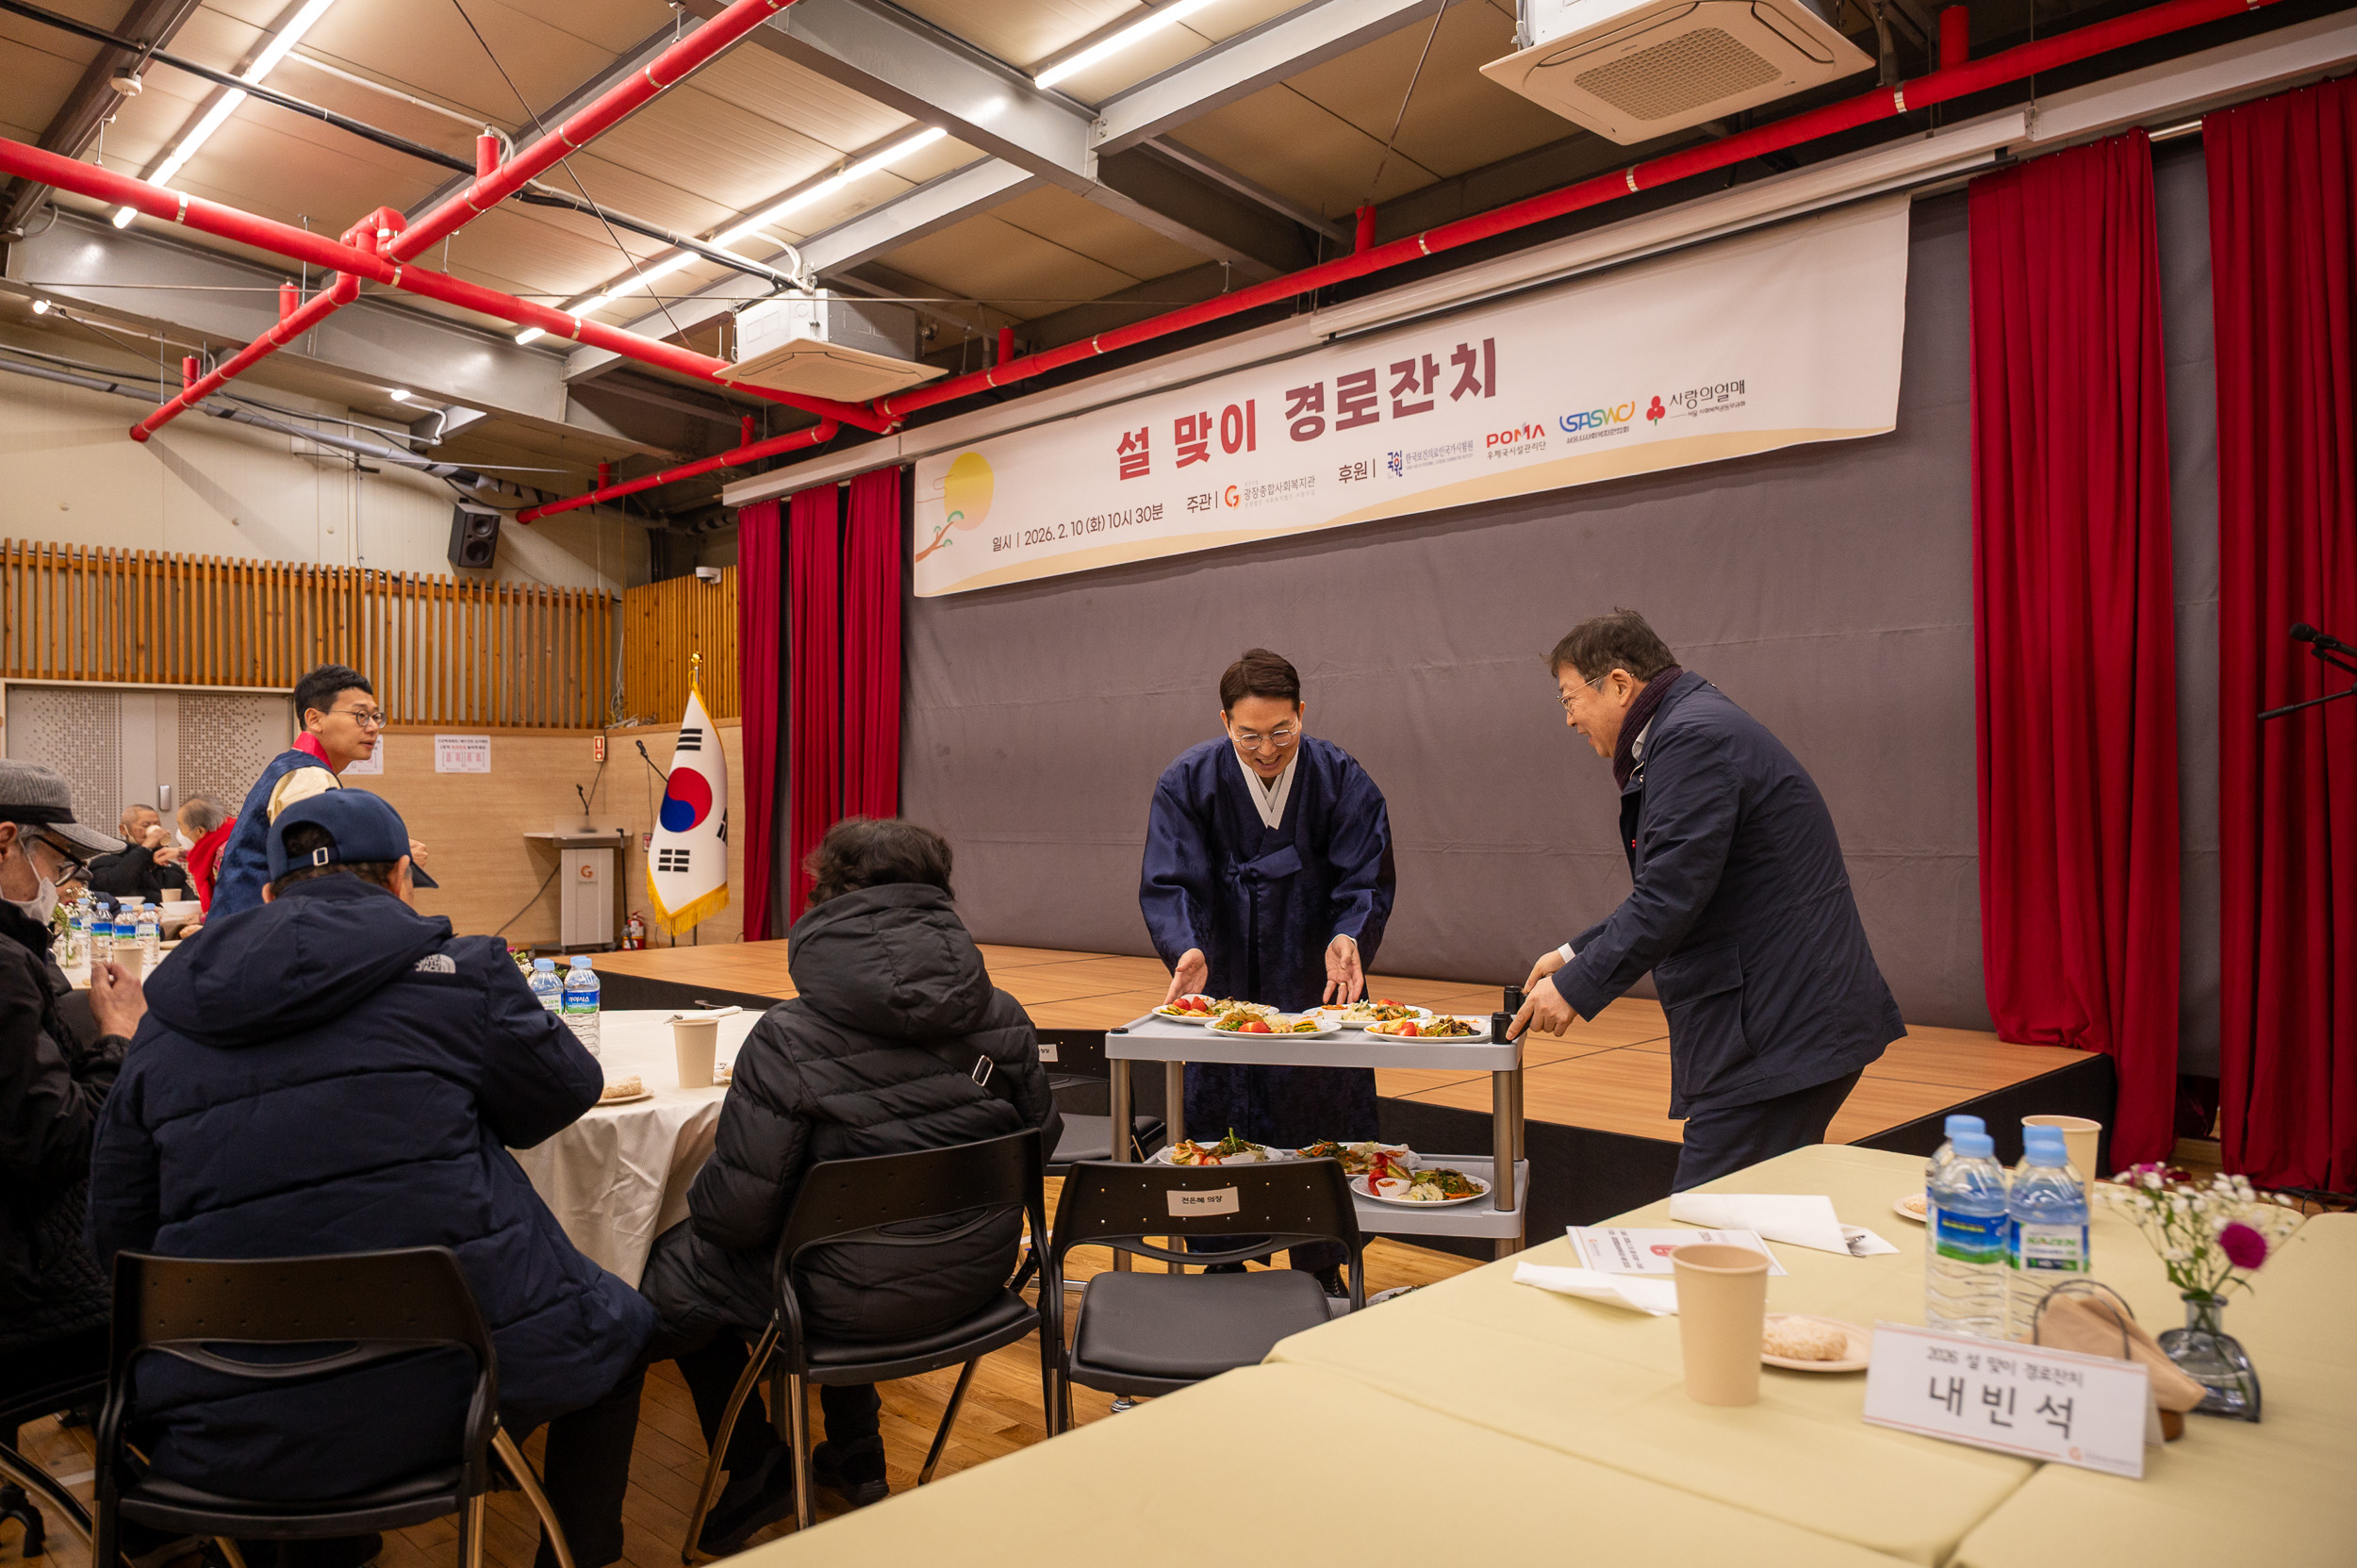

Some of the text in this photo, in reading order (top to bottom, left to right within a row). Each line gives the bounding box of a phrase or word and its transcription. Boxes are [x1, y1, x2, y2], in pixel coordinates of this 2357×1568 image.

[1669, 379, 1745, 410] 사랑의열매
[1116, 337, 1496, 481] 설 맞이 경로잔치
[1486, 422, 1545, 448] POMA
[1405, 439, 1474, 465] 한국보건의료인국가시험원
[1487, 441, 1546, 461] 우체국시설관리단
[1338, 460, 1368, 484] 후원
[1244, 475, 1316, 502] 광장종합사회복지관
[1187, 492, 1212, 514] 주관
[993, 534, 1012, 553] 일시
[1025, 527, 1056, 546] 2026.
[1070, 520, 1083, 536] 10
[1108, 509, 1132, 529] 10시
[1135, 503, 1163, 524] 30분
[581, 865, 593, 879] G
[1180, 1195, 1223, 1205] 전은혜 의장
[1926, 1345, 2084, 1389] 2026 설 맞이 경로잔치
